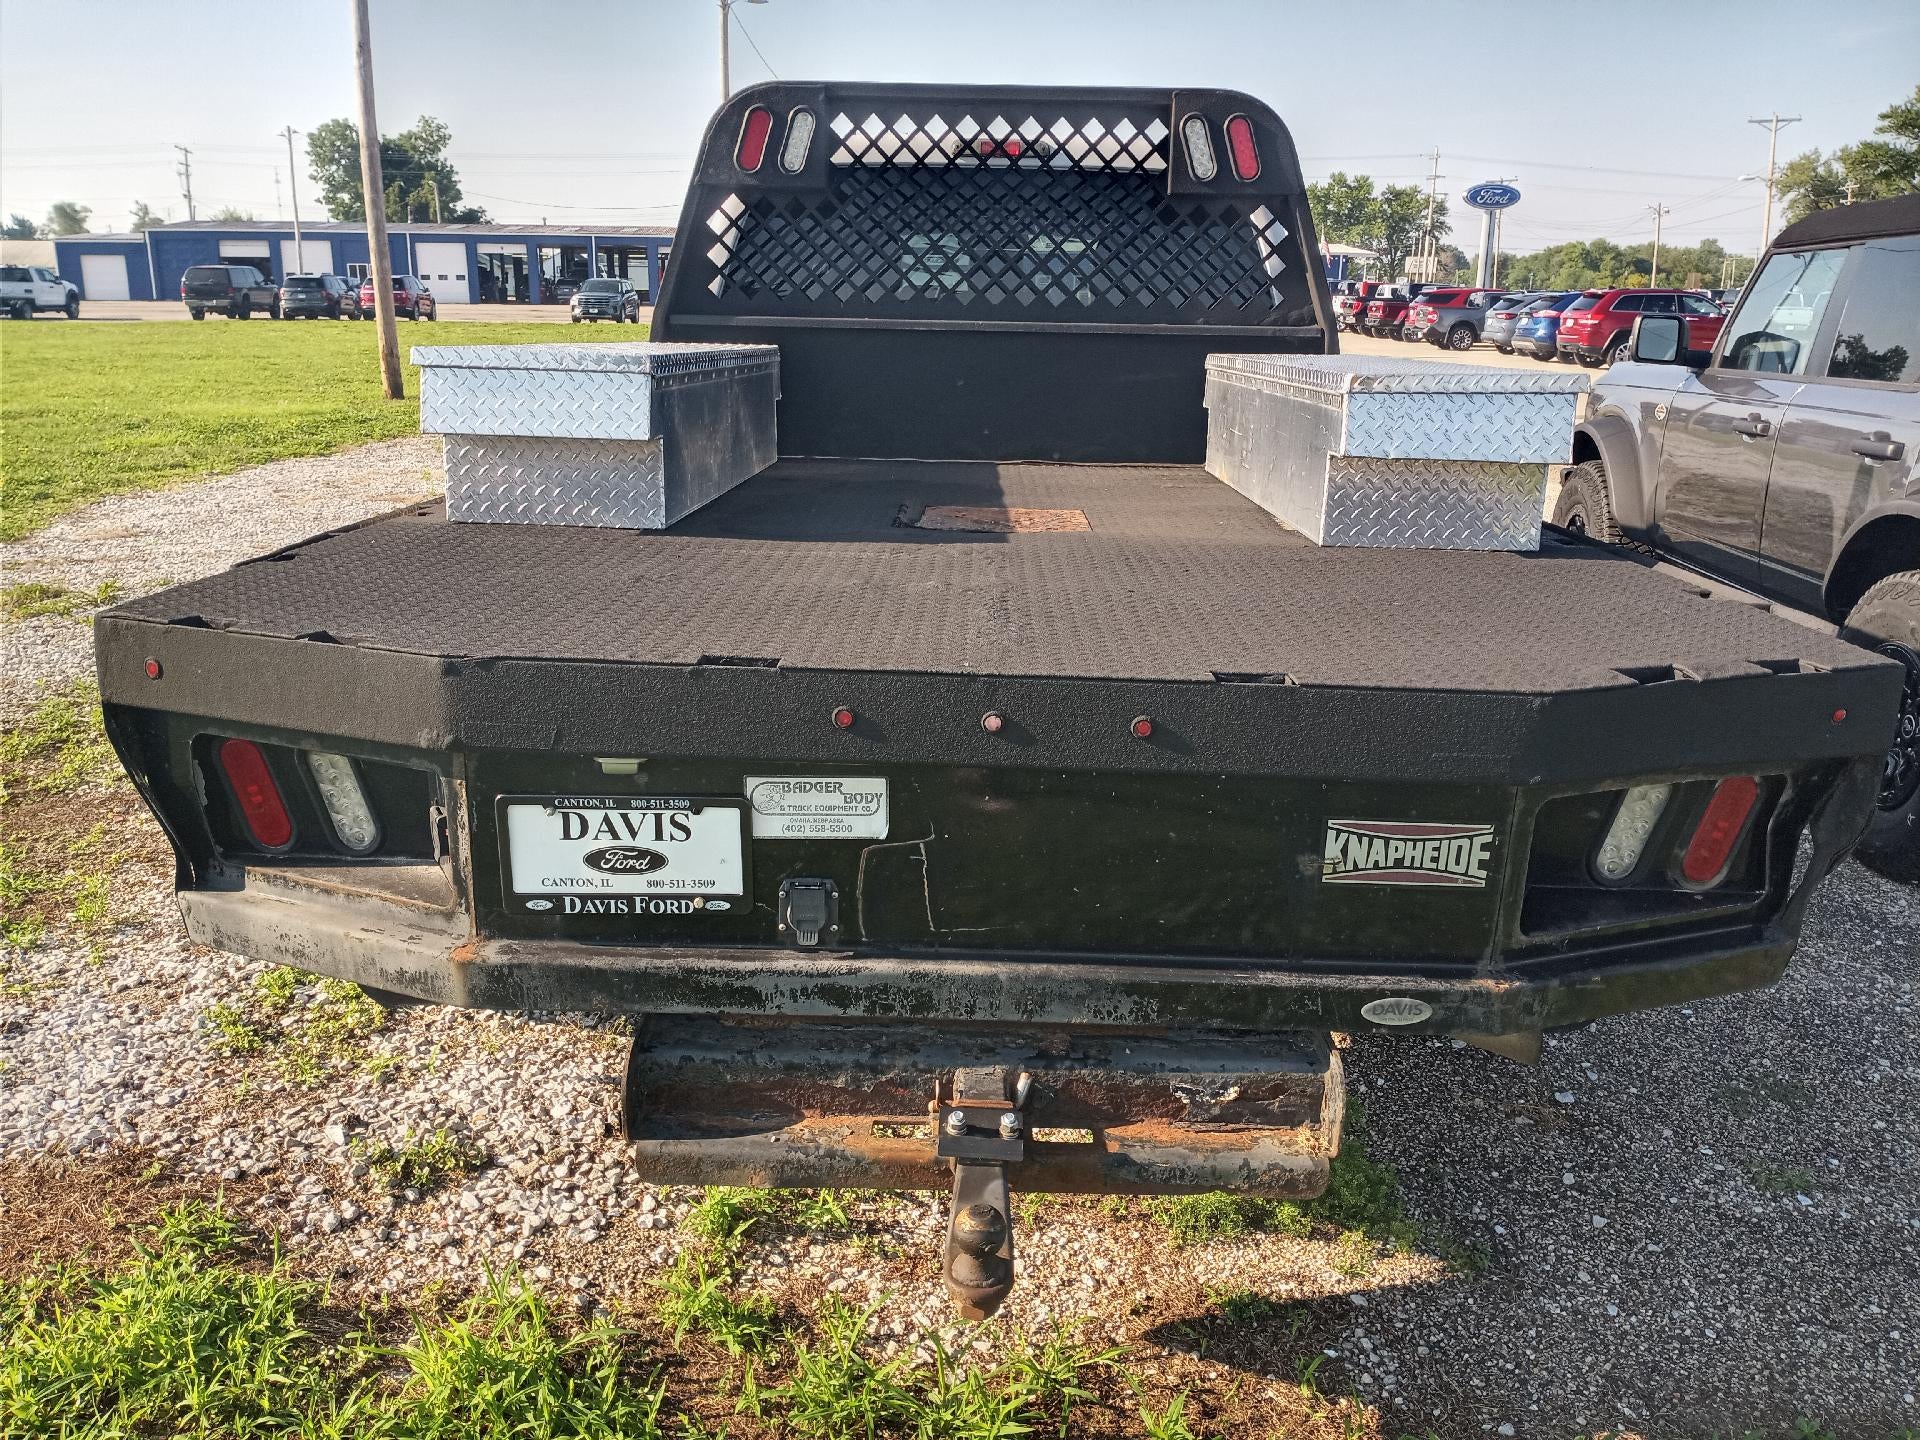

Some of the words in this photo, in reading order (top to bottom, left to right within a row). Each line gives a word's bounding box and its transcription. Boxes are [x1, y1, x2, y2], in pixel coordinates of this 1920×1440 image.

[1477, 188, 1510, 205] Ford
[781, 781, 844, 794] BADGER
[555, 798, 604, 808] CANTON,
[605, 798, 617, 808] IL
[631, 799, 690, 809] 800-511-3509
[843, 792, 884, 804] BODY
[558, 810, 692, 843] DAVIS
[781, 824, 806, 834] (402)
[600, 849, 651, 870] Ford
[1323, 829, 1494, 879] KNAPHEIDE
[541, 877, 598, 889] CANTON,
[601, 878, 614, 888] IL
[646, 879, 716, 889] 800-511-3509
[563, 896, 628, 914] DAVIS
[633, 896, 694, 914] FORD
[1372, 1003, 1423, 1016] DAVIS
